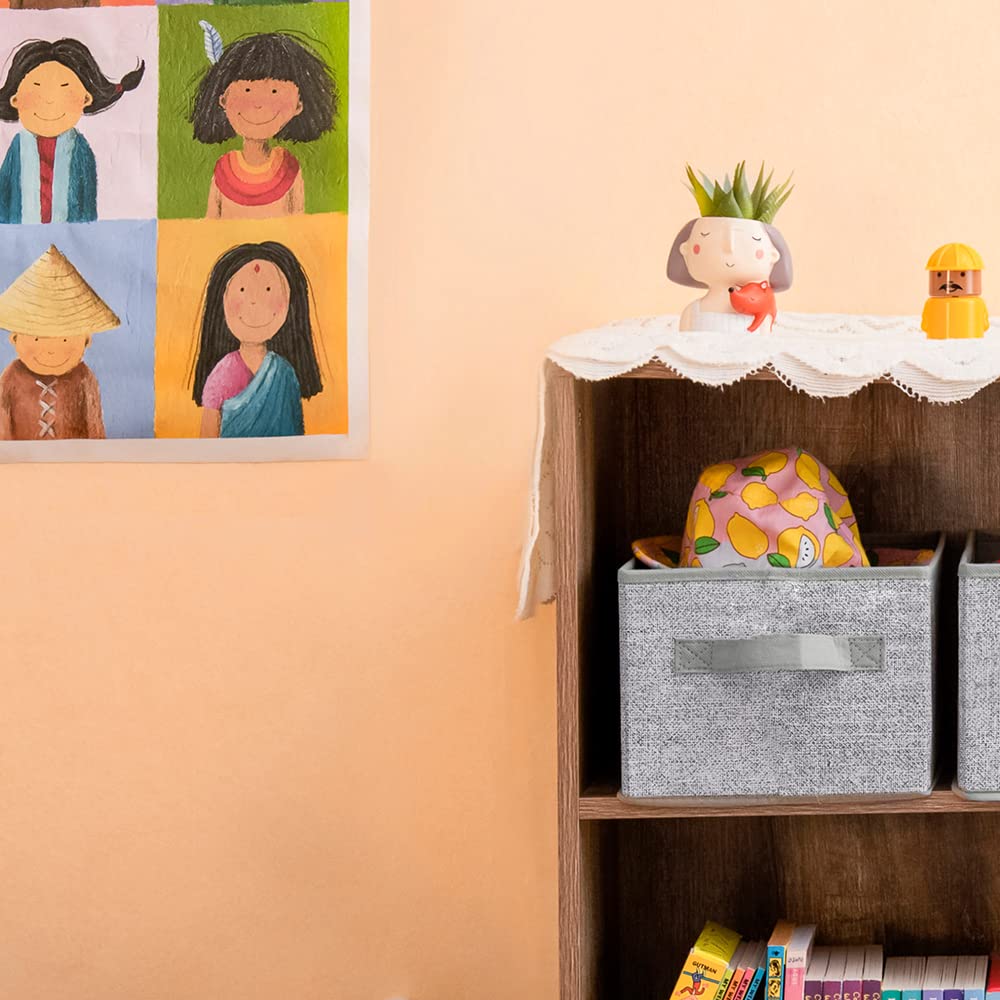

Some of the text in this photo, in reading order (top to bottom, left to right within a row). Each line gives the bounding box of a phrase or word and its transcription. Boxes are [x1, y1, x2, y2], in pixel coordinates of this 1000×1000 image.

[692, 960, 717, 974] GUTMAN
[721, 977, 729, 987] MY
[730, 980, 738, 991] MY
[741, 978, 749, 989] MY
[752, 978, 760, 987] MY
